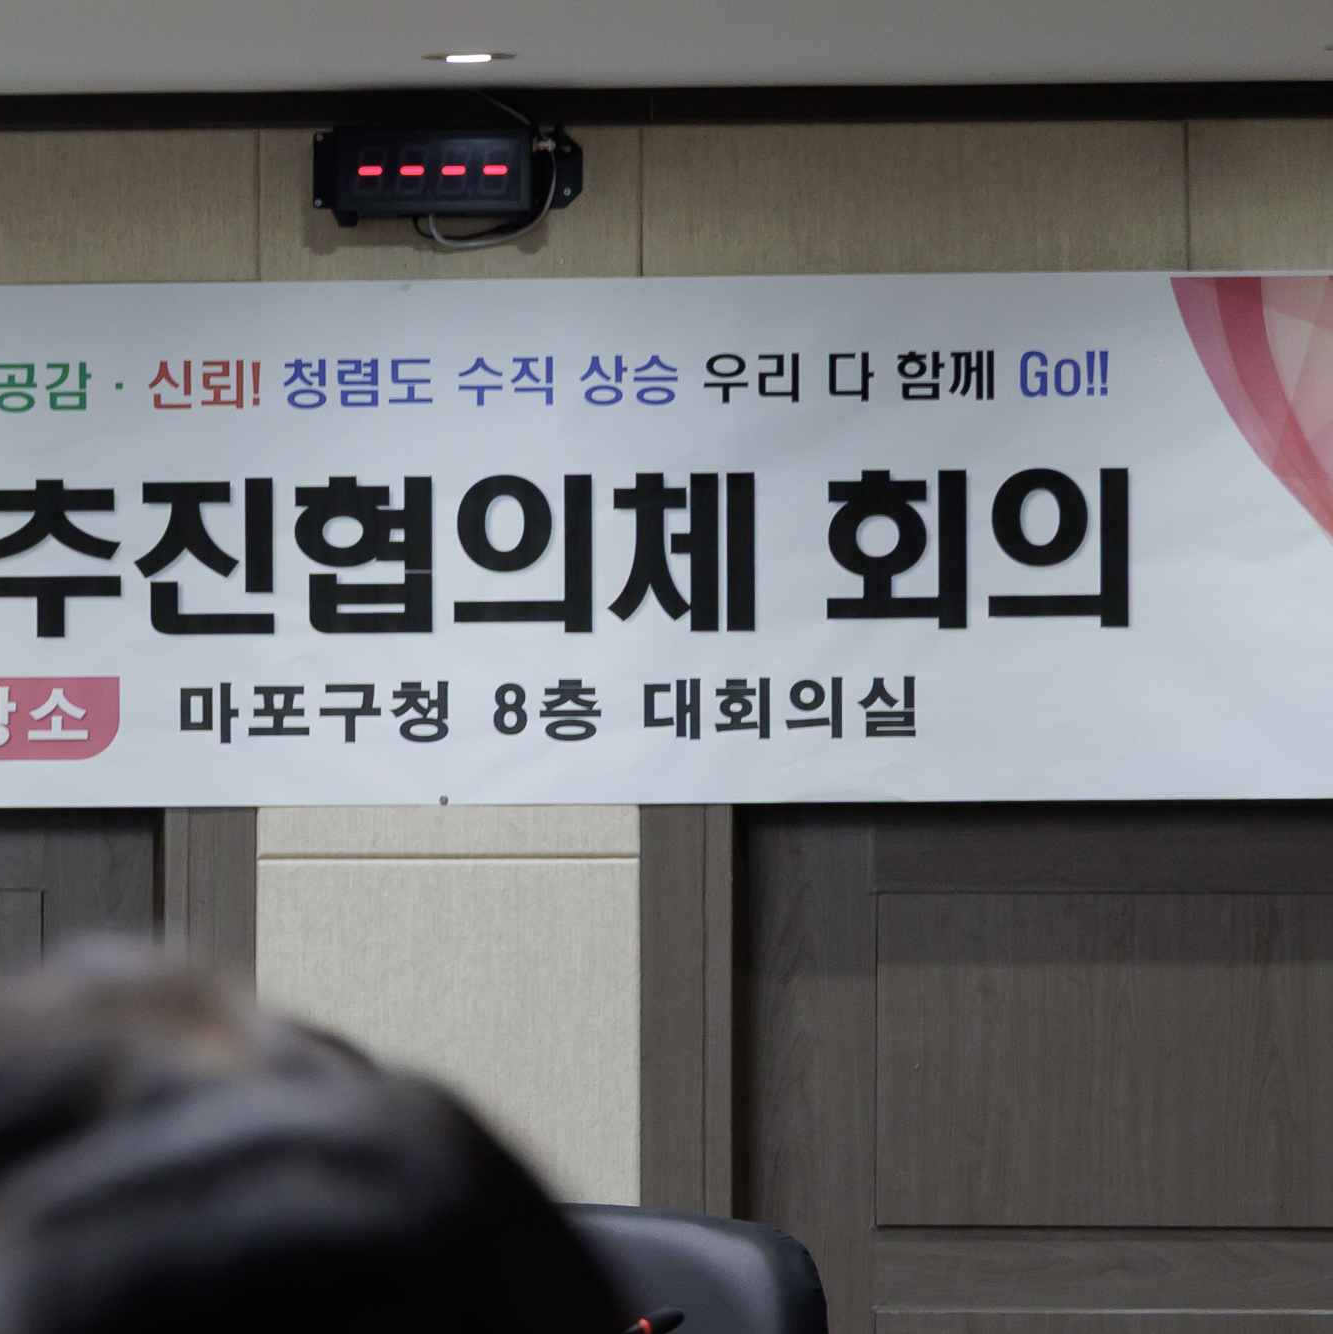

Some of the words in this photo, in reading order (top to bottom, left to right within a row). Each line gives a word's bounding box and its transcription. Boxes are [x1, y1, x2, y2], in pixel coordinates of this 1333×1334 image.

[148, 358, 263, 411] 신뢰!
[283, 356, 435, 411] 청렴도
[458, 355, 555, 408] 수직
[579, 354, 680, 408] 상승
[703, 352, 801, 406] 우리
[827, 351, 876, 403] 다
[896, 349, 996, 403] 함께
[1019, 349, 1110, 400] Go!!
[826, 467, 1133, 631] 회의
[180, 681, 451, 746] 마포구청
[493, 679, 604, 744] 8층
[643, 676, 918, 742] 대회의실
